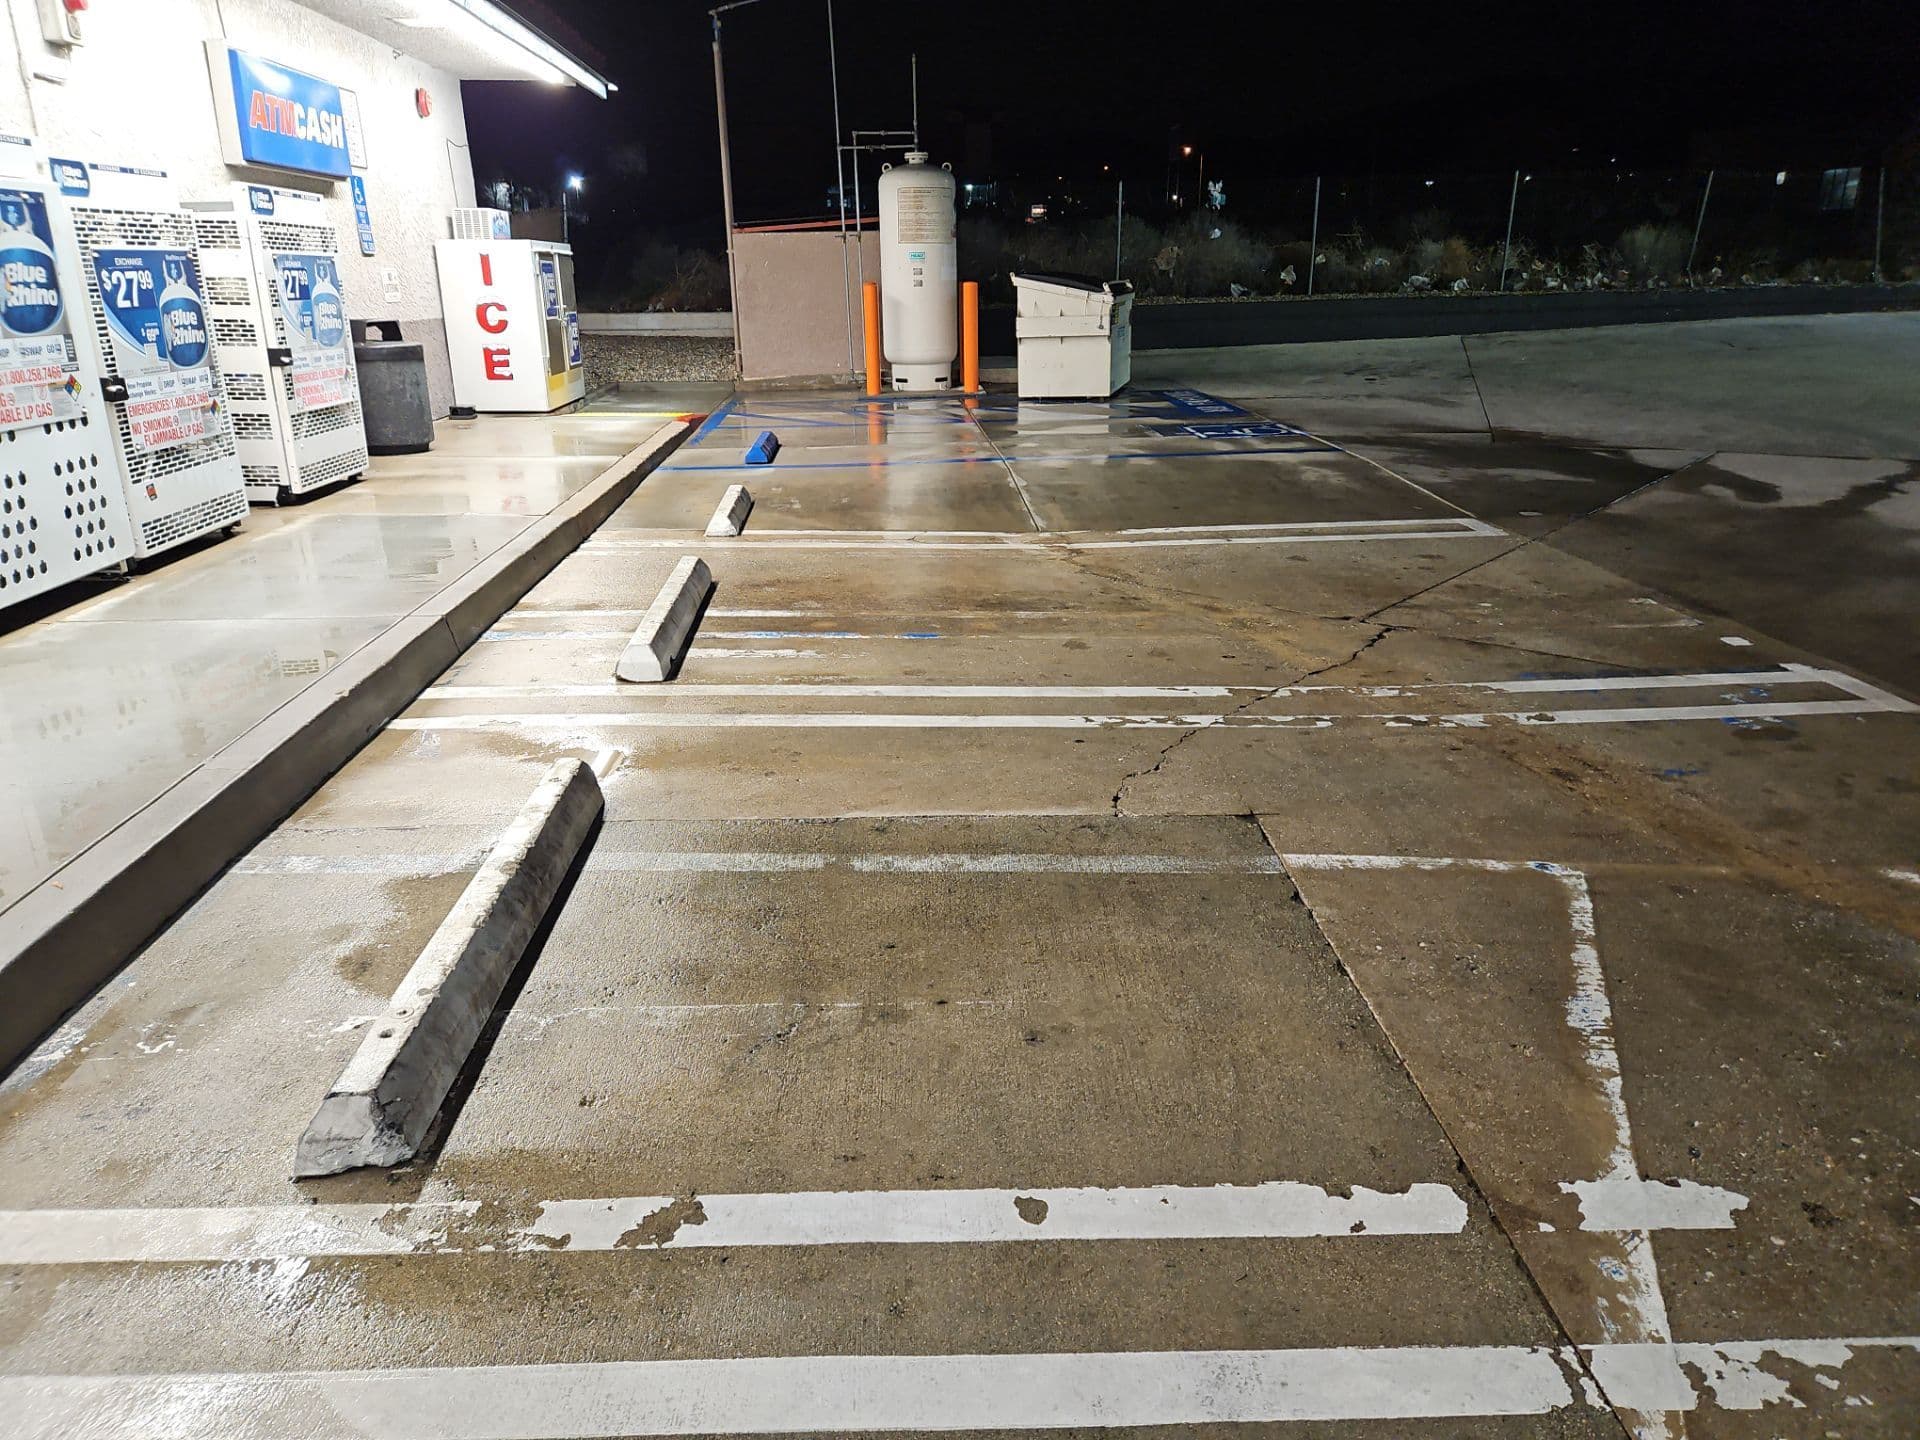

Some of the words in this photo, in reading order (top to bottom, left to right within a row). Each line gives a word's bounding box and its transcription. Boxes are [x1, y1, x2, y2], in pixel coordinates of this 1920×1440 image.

[250, 90, 297, 138] ATM
[294, 102, 344, 149] CASH
[115, 257, 143, 266] EXCHANGE
[5, 262, 47, 282] Blue
[171, 309, 198, 326] Blue
[476, 253, 513, 380] ICE
[24, 405, 33, 420] LP
[36, 403, 52, 417] GAS
[131, 422, 142, 435] NO
[142, 415, 174, 433] SMOKING
[144, 426, 184, 446] FLAMMABLE
[184, 425, 192, 437] LP
[192, 422, 204, 436] GAS
